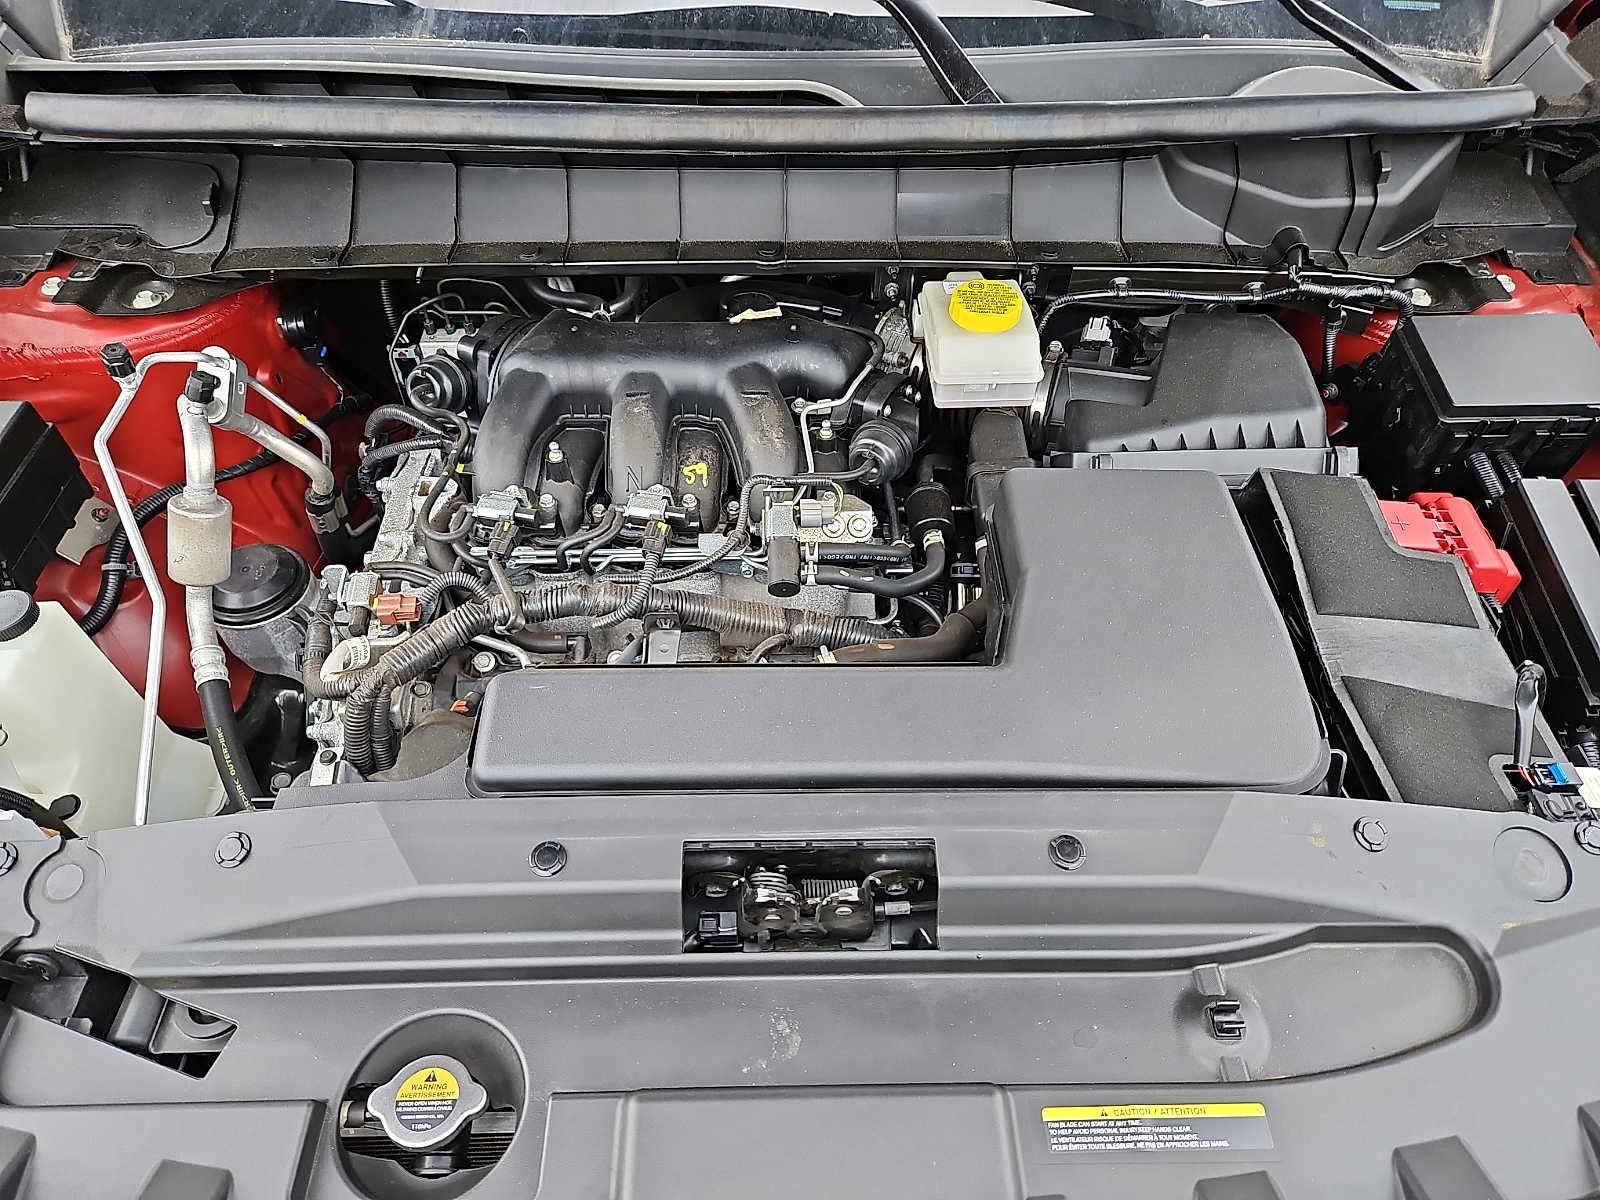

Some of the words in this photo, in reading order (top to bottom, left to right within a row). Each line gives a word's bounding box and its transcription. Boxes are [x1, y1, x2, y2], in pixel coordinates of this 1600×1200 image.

[683, 461, 709, 488] 59
[411, 1083, 448, 1091] WARNING
[1113, 1108, 1151, 1116] CAUTION
[1160, 1107, 1206, 1116] ATTENTION
